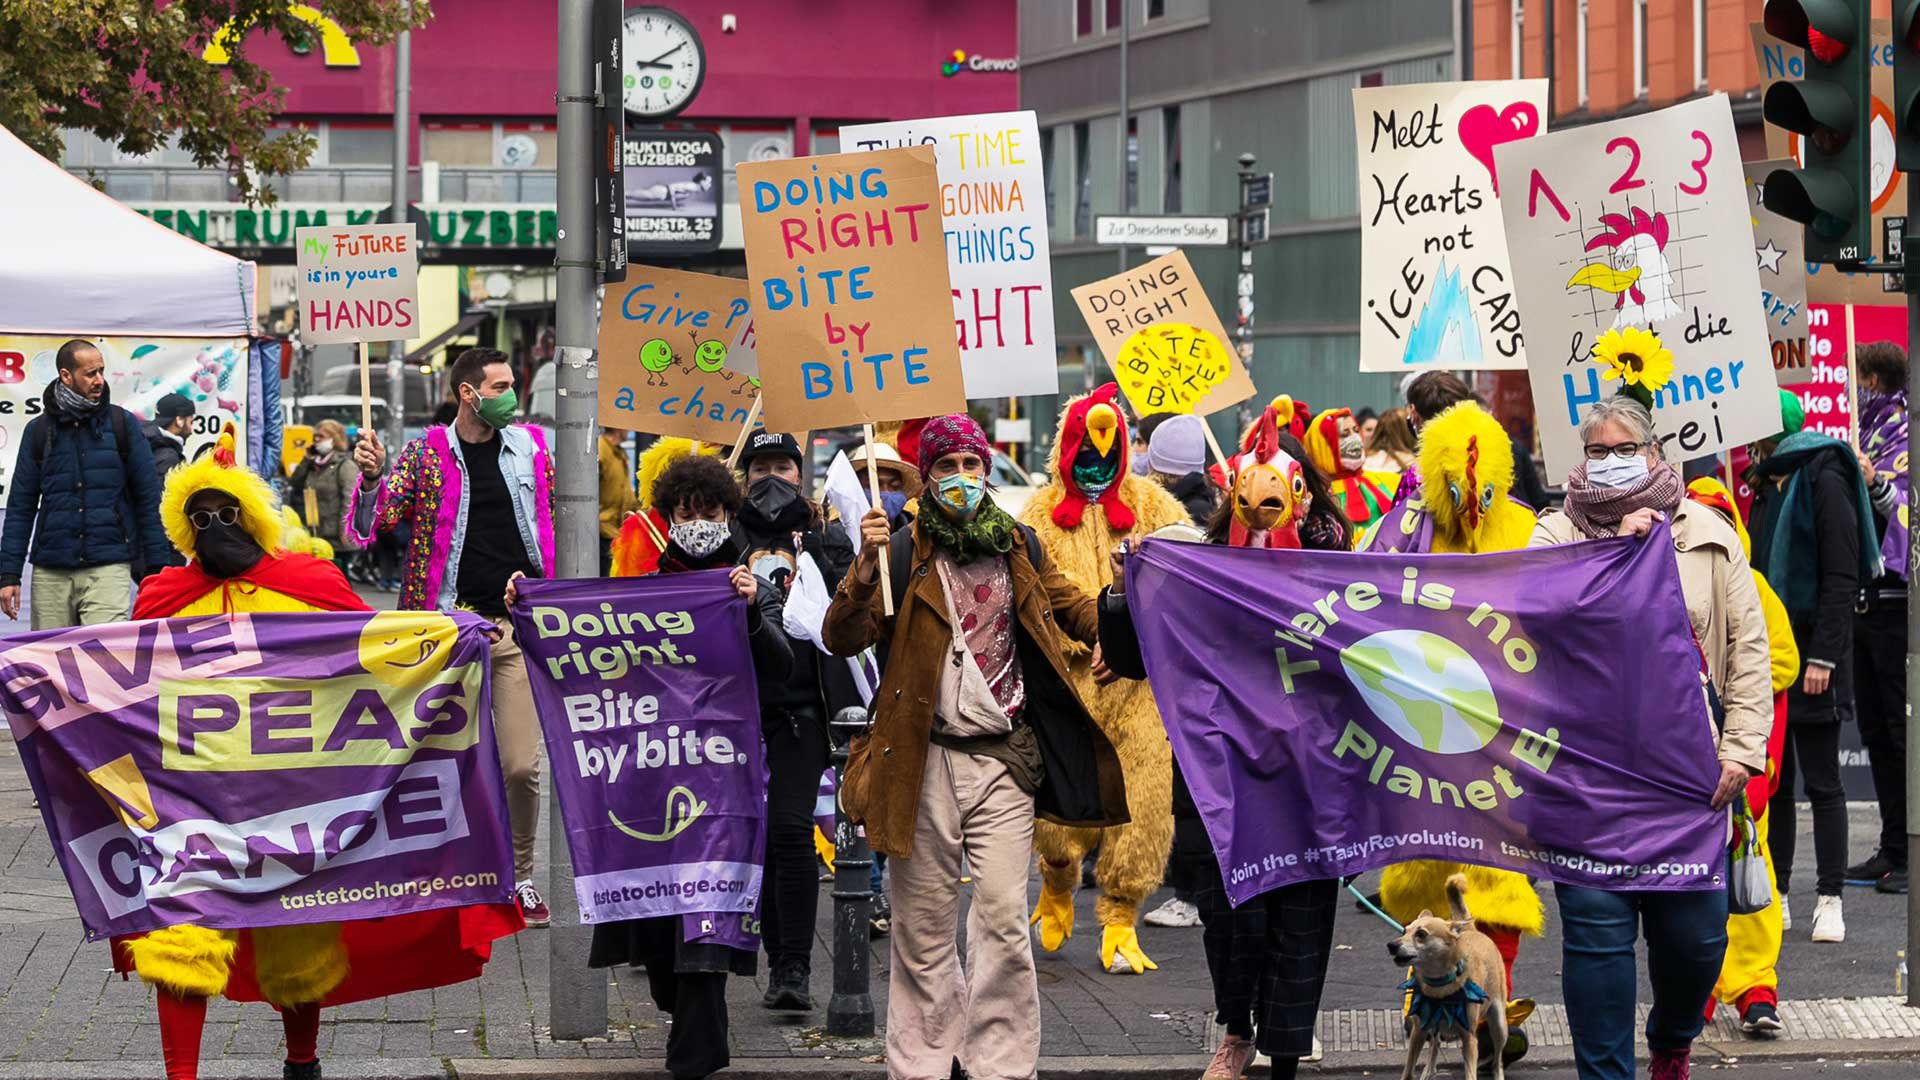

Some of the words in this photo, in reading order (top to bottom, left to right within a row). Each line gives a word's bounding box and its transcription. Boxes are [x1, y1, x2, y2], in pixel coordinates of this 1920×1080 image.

[970, 55, 1018, 71] Gewo
[1371, 103, 1443, 153] Melt
[670, 141, 713, 154] YOGA
[941, 179, 1024, 217] GONNA
[1372, 172, 1483, 226] Hearts
[695, 218, 714, 232] 25
[1109, 223, 1125, 236] Zur
[1424, 224, 1475, 254] not
[304, 237, 329, 264] My
[1840, 246, 1857, 260] K21
[345, 266, 398, 289] youre
[310, 298, 412, 332] HANDS
[622, 284, 710, 328] Give
[1472, 265, 1525, 358] CAPS
[1684, 305, 1733, 344] die
[614, 387, 636, 412] a
[532, 602, 695, 639] Doing
[1274, 579, 1383, 695] There
[1401, 566, 1456, 612] is
[1466, 601, 1539, 674] no
[546, 638, 697, 681] right.
[177, 681, 468, 756] PEAS
[563, 688, 659, 733] Bite
[573, 739, 629, 784] by
[636, 725, 748, 769] bite.
[1332, 719, 1524, 811] Planet
[1231, 863, 1260, 885] Join
[1263, 850, 1299, 872] the
[1304, 829, 1485, 864] #TastyRevolution
[280, 872, 498, 910] tastetochange.com
